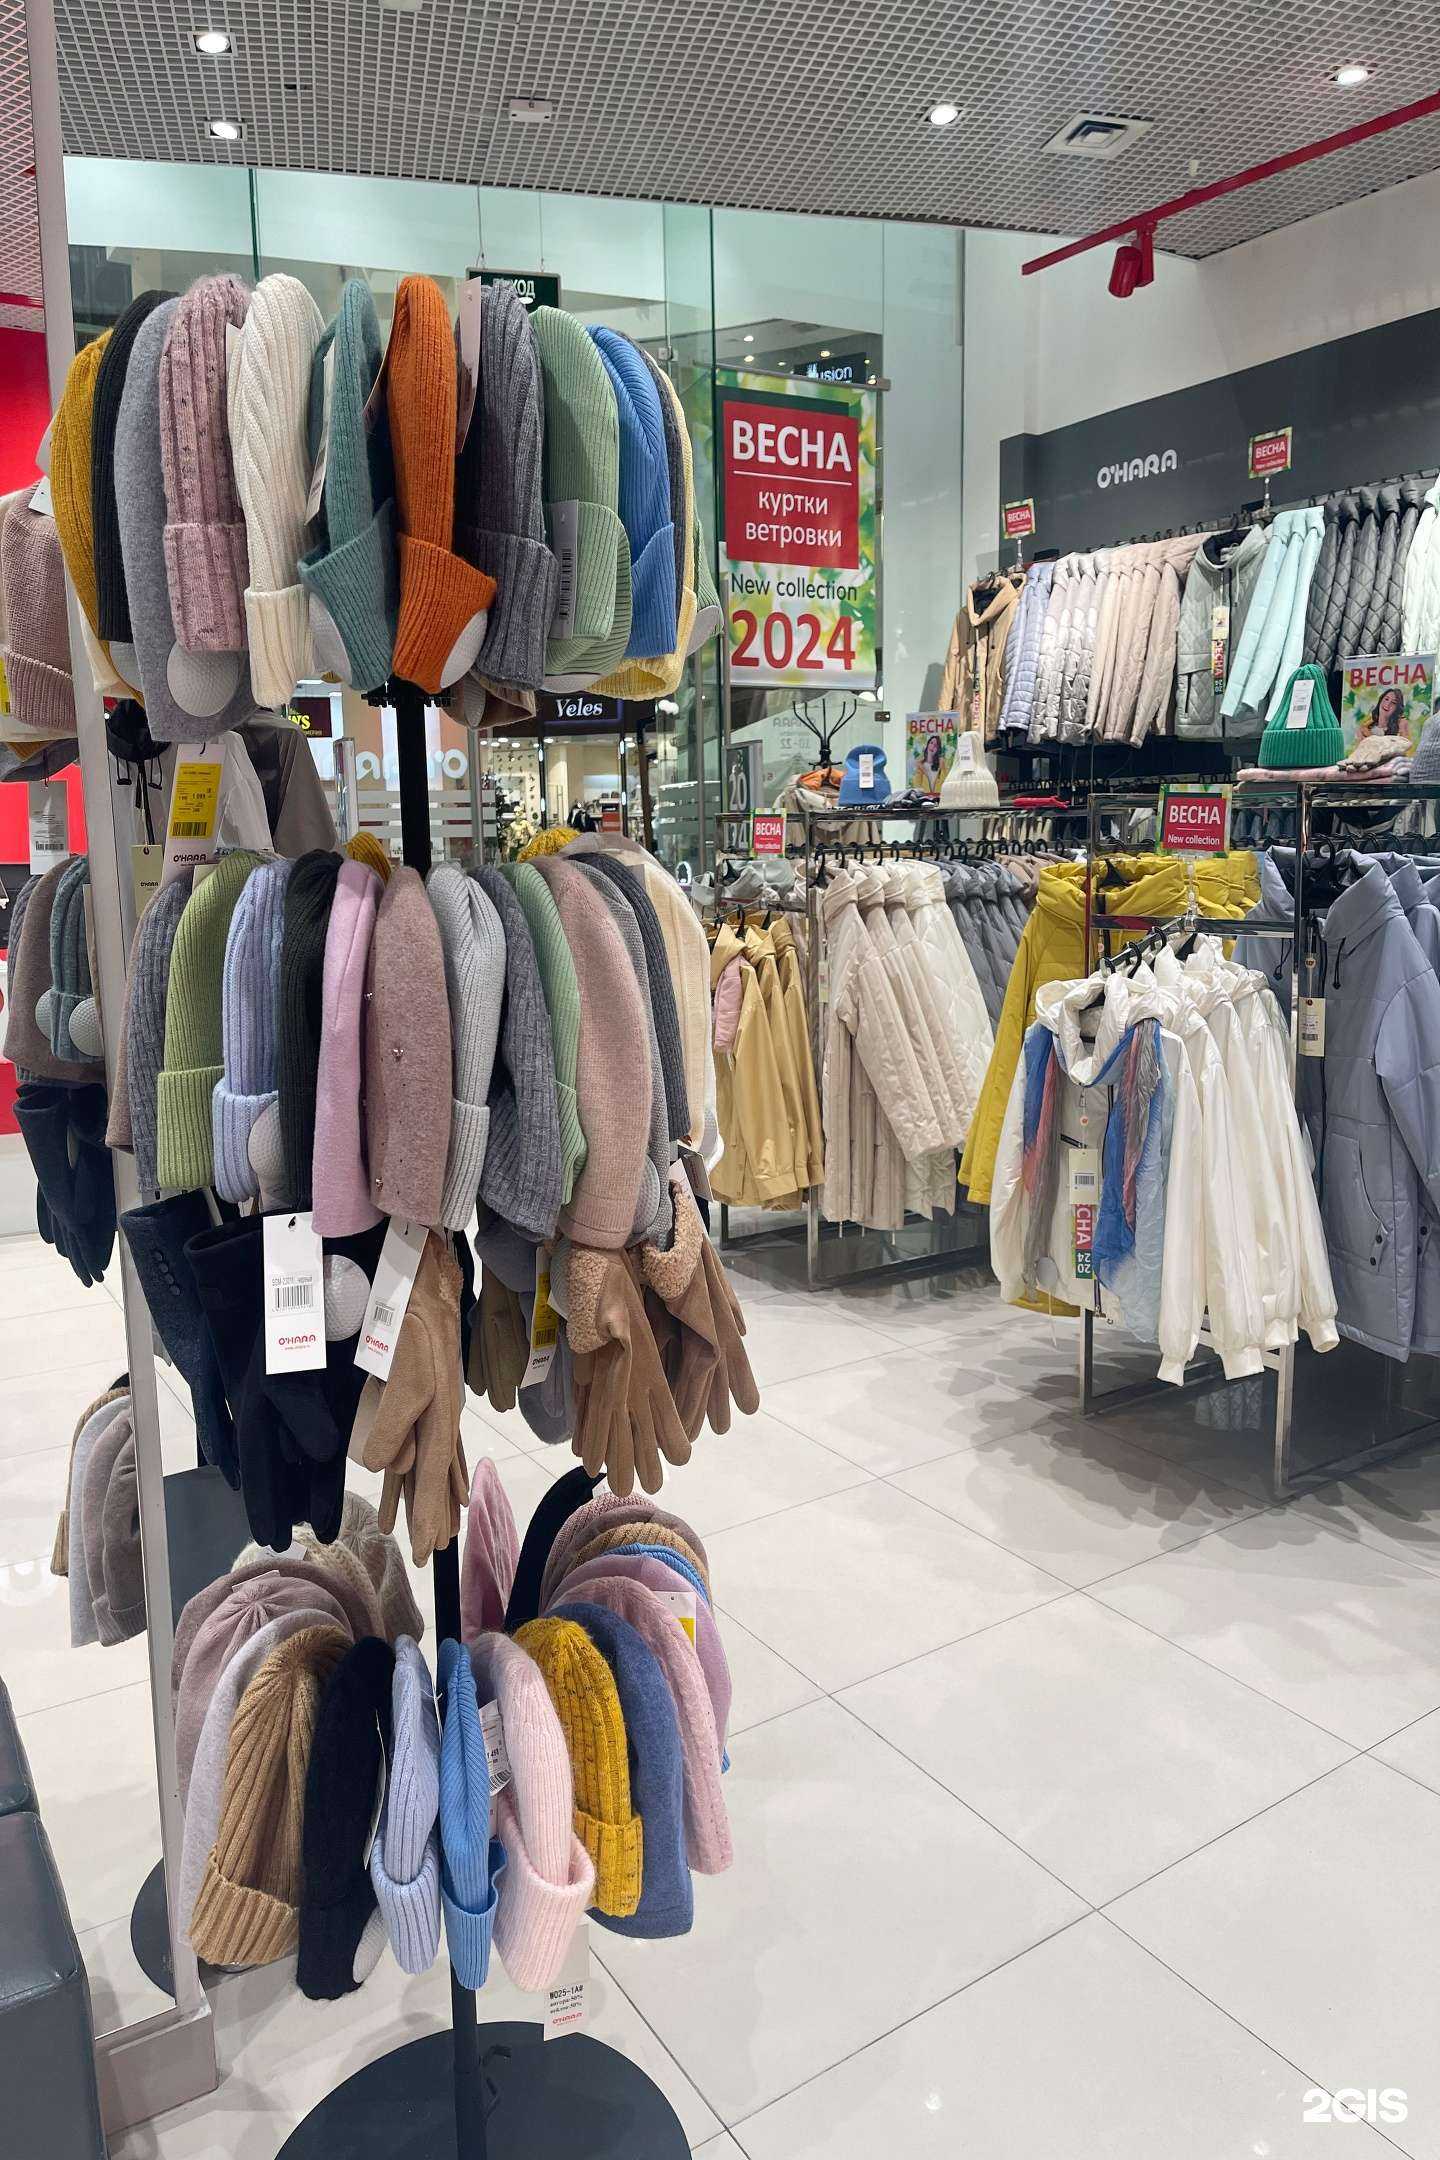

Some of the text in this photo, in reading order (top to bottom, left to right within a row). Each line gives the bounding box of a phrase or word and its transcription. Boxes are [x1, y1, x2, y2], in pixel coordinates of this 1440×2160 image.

[732, 419, 852, 473] ВЕСНА
[1255, 440, 1287, 459] ВЕСНА
[1097, 449, 1178, 489] O'HARA
[758, 491, 828, 517] куртки
[1007, 510, 1031, 524] ВЕСНА
[746, 522, 842, 548] ветровки
[731, 573, 857, 601] New collection
[731, 609, 856, 671] 2024
[1350, 663, 1427, 688] ВЕСНА
[910, 718, 955, 735] ВЕСНА
[1169, 805, 1221, 825] ВЕСНА
[755, 823, 781, 836] ВЕСНА
[1168, 834, 1220, 846] New collection
[1076, 1204, 1092, 1245] СНА
[278, 1334, 316, 1346] O'HARA
